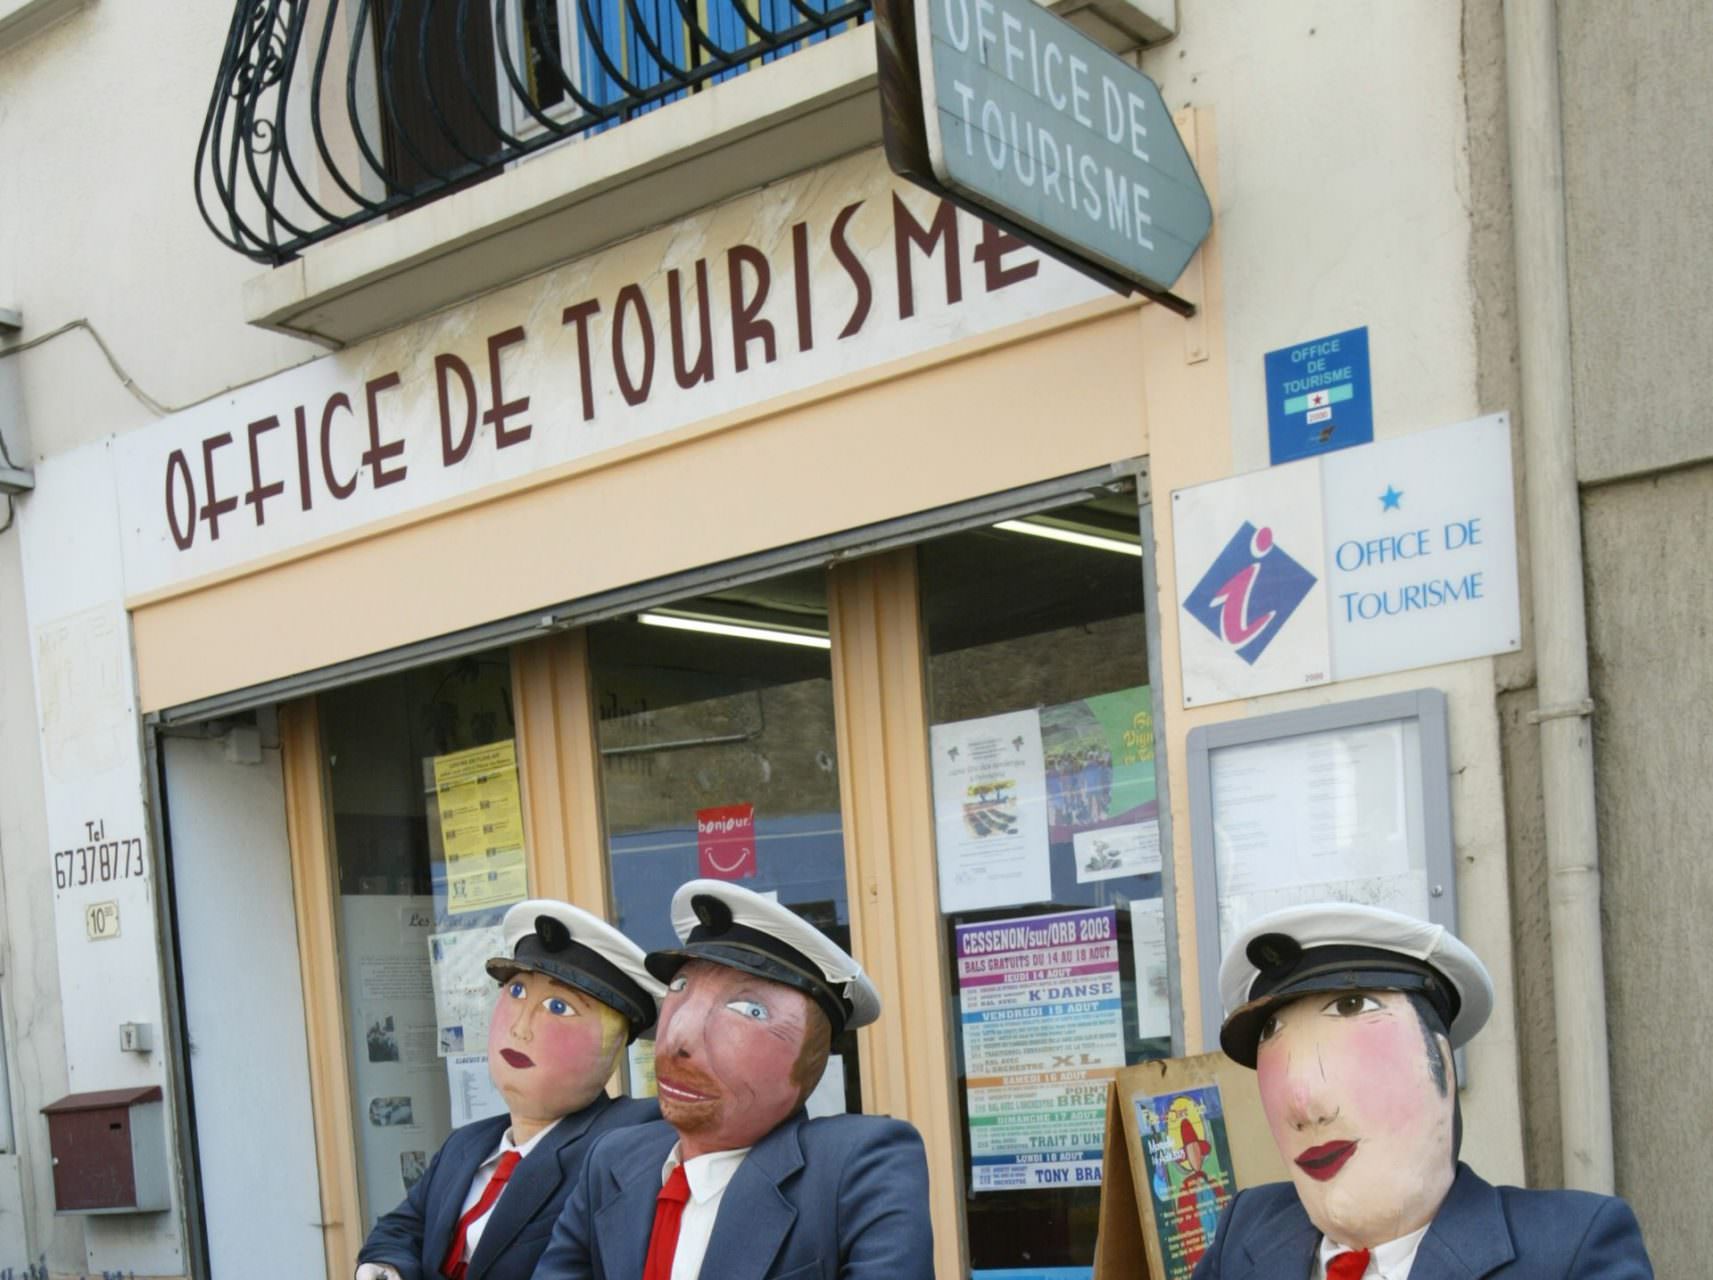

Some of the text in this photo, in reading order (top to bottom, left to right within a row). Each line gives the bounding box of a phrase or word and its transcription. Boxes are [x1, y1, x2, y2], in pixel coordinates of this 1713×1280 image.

[944, 0, 1149, 163] OFFICE DE
[953, 79, 1155, 251] TOURISME
[1291, 339, 1341, 363] OFFICE
[164, 189, 1040, 552] OFFICE DE TOURISME
[1307, 358, 1327, 374] DE
[1283, 366, 1353, 394] TOURISME
[1335, 518, 1483, 573] OFFICE DE
[1338, 571, 1485, 624] TOURISME
[85, 818, 105, 842] Tel
[1080, 916, 1111, 942] 2003
[964, 959, 986, 974] BALS
[988, 955, 1031, 972] GRATUITS
[1032, 953, 1045, 966] DU
[1048, 952, 1059, 965] 14
[1061, 950, 1073, 964] AU
[1089, 945, 1111, 960] AOUT
[1004, 967, 1073, 983] JEUDI 14 AOUT
[982, 1007, 1043, 1021] VENDREDI
[1068, 1001, 1100, 1013] AOUT
[1003, 1073, 1041, 1085] SAMEDI
[1060, 1069, 1088, 1081] AOUT
[997, 1110, 1098, 1124] DIMANCHE 17 AOUT
[1029, 1135, 1068, 1148] TRAIT
[1016, 1153, 1043, 1163] LUNDI
[1059, 1151, 1084, 1161] AOUT
[1035, 1169, 1070, 1183] TONY
